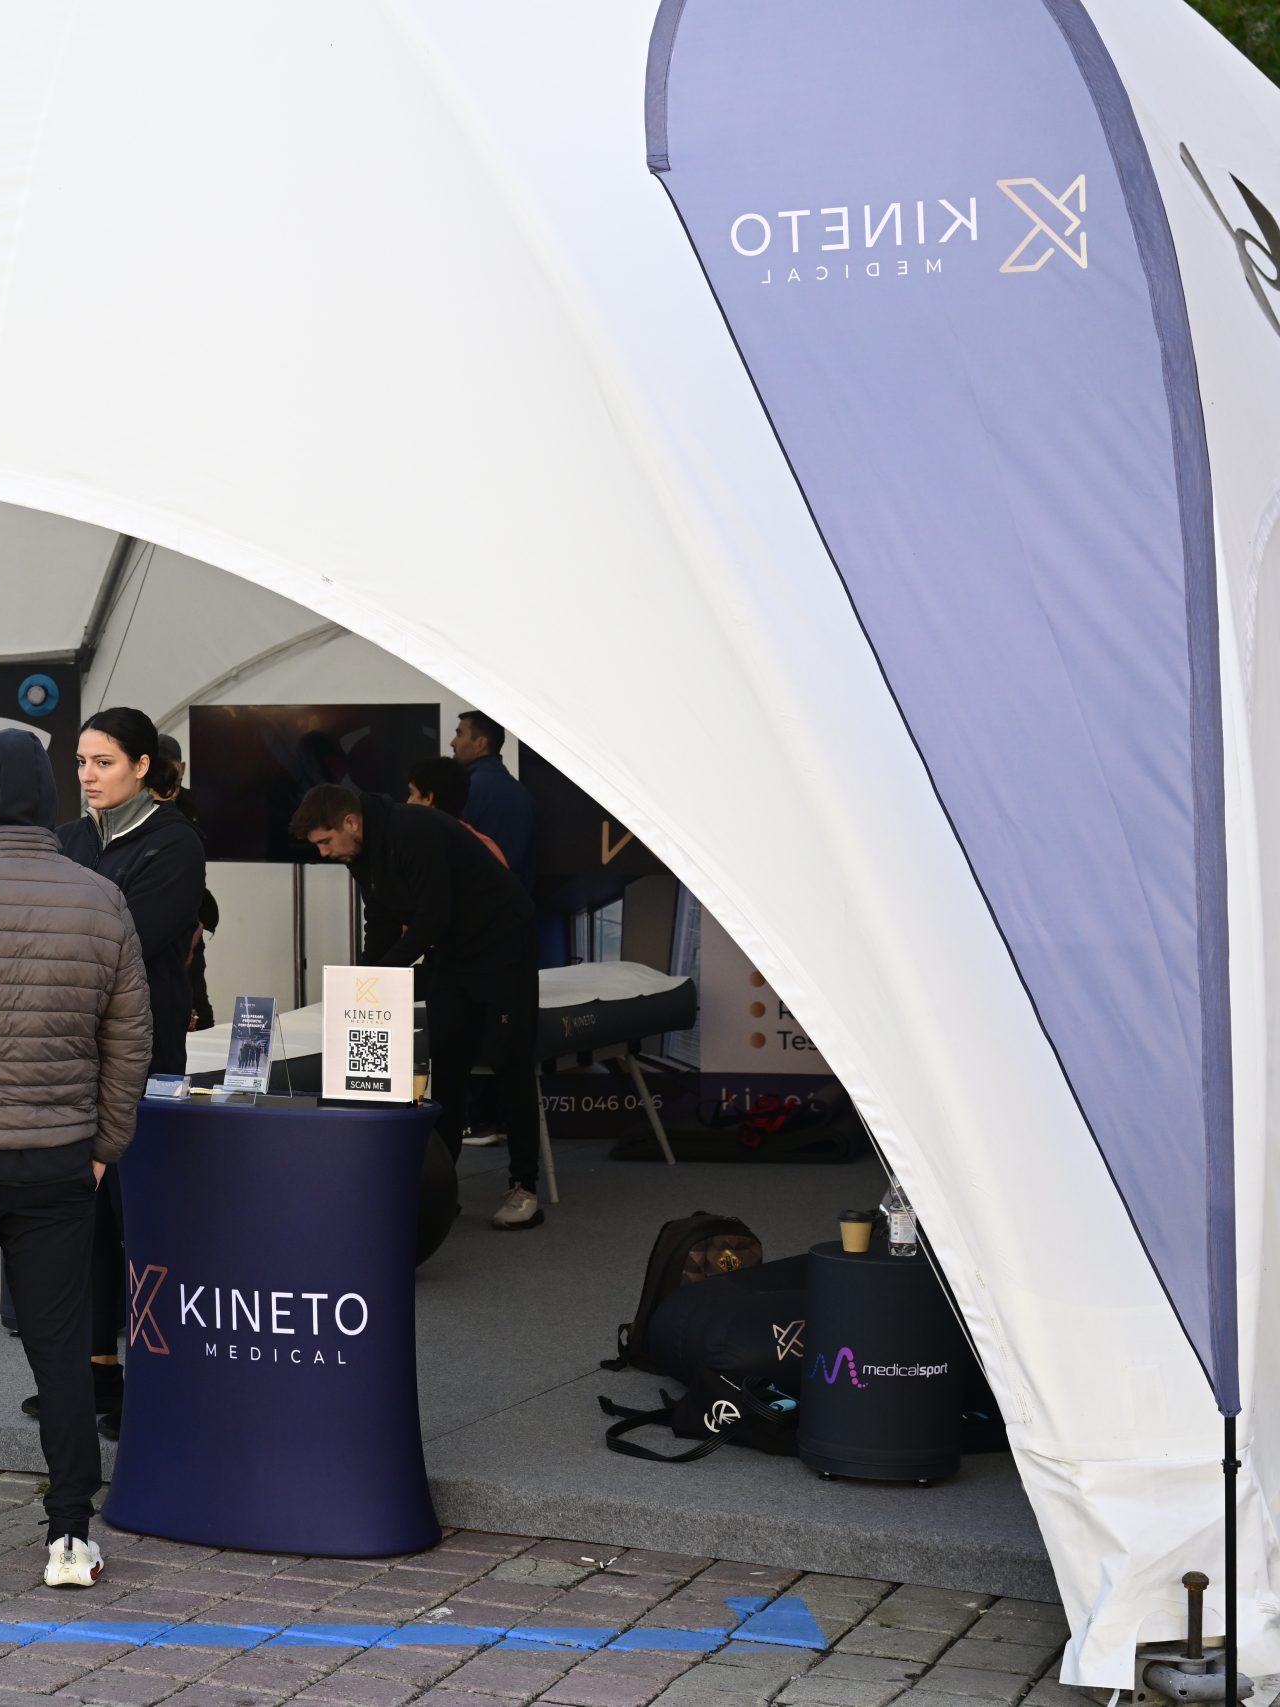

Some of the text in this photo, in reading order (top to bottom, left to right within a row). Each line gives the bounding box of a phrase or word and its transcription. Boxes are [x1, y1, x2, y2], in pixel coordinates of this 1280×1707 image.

[344, 1009, 392, 1021] KINETO
[350, 1080, 385, 1091] SCAN ME
[581, 1095, 620, 1112] 046
[179, 1283, 369, 1336] KINETO
[204, 1342, 347, 1365] MEDICAL
[862, 1362, 948, 1379] medicalsport
